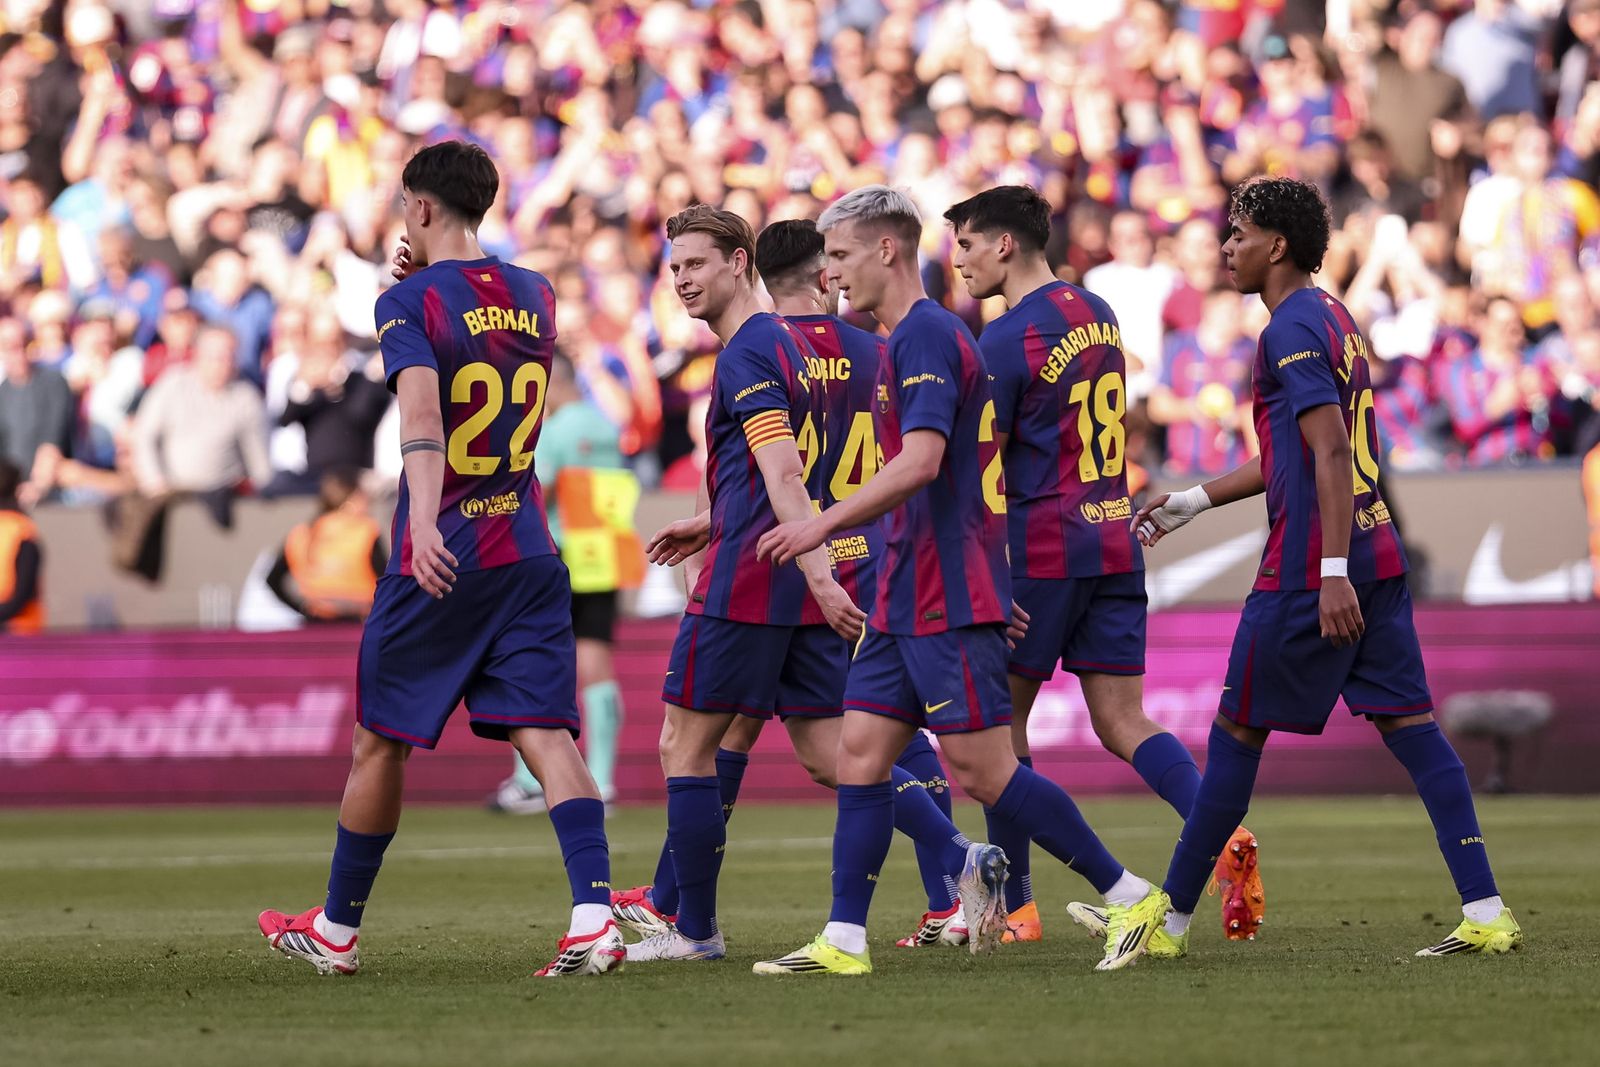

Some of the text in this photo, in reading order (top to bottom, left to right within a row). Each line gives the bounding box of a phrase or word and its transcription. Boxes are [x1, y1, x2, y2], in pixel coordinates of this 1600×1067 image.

[463, 306, 541, 338] BERNAL
[1039, 322, 1126, 384] GERARD MAR
[447, 361, 548, 475] 22
[734, 380, 771, 403] AMBILIGHT
[1068, 371, 1127, 483] 18
